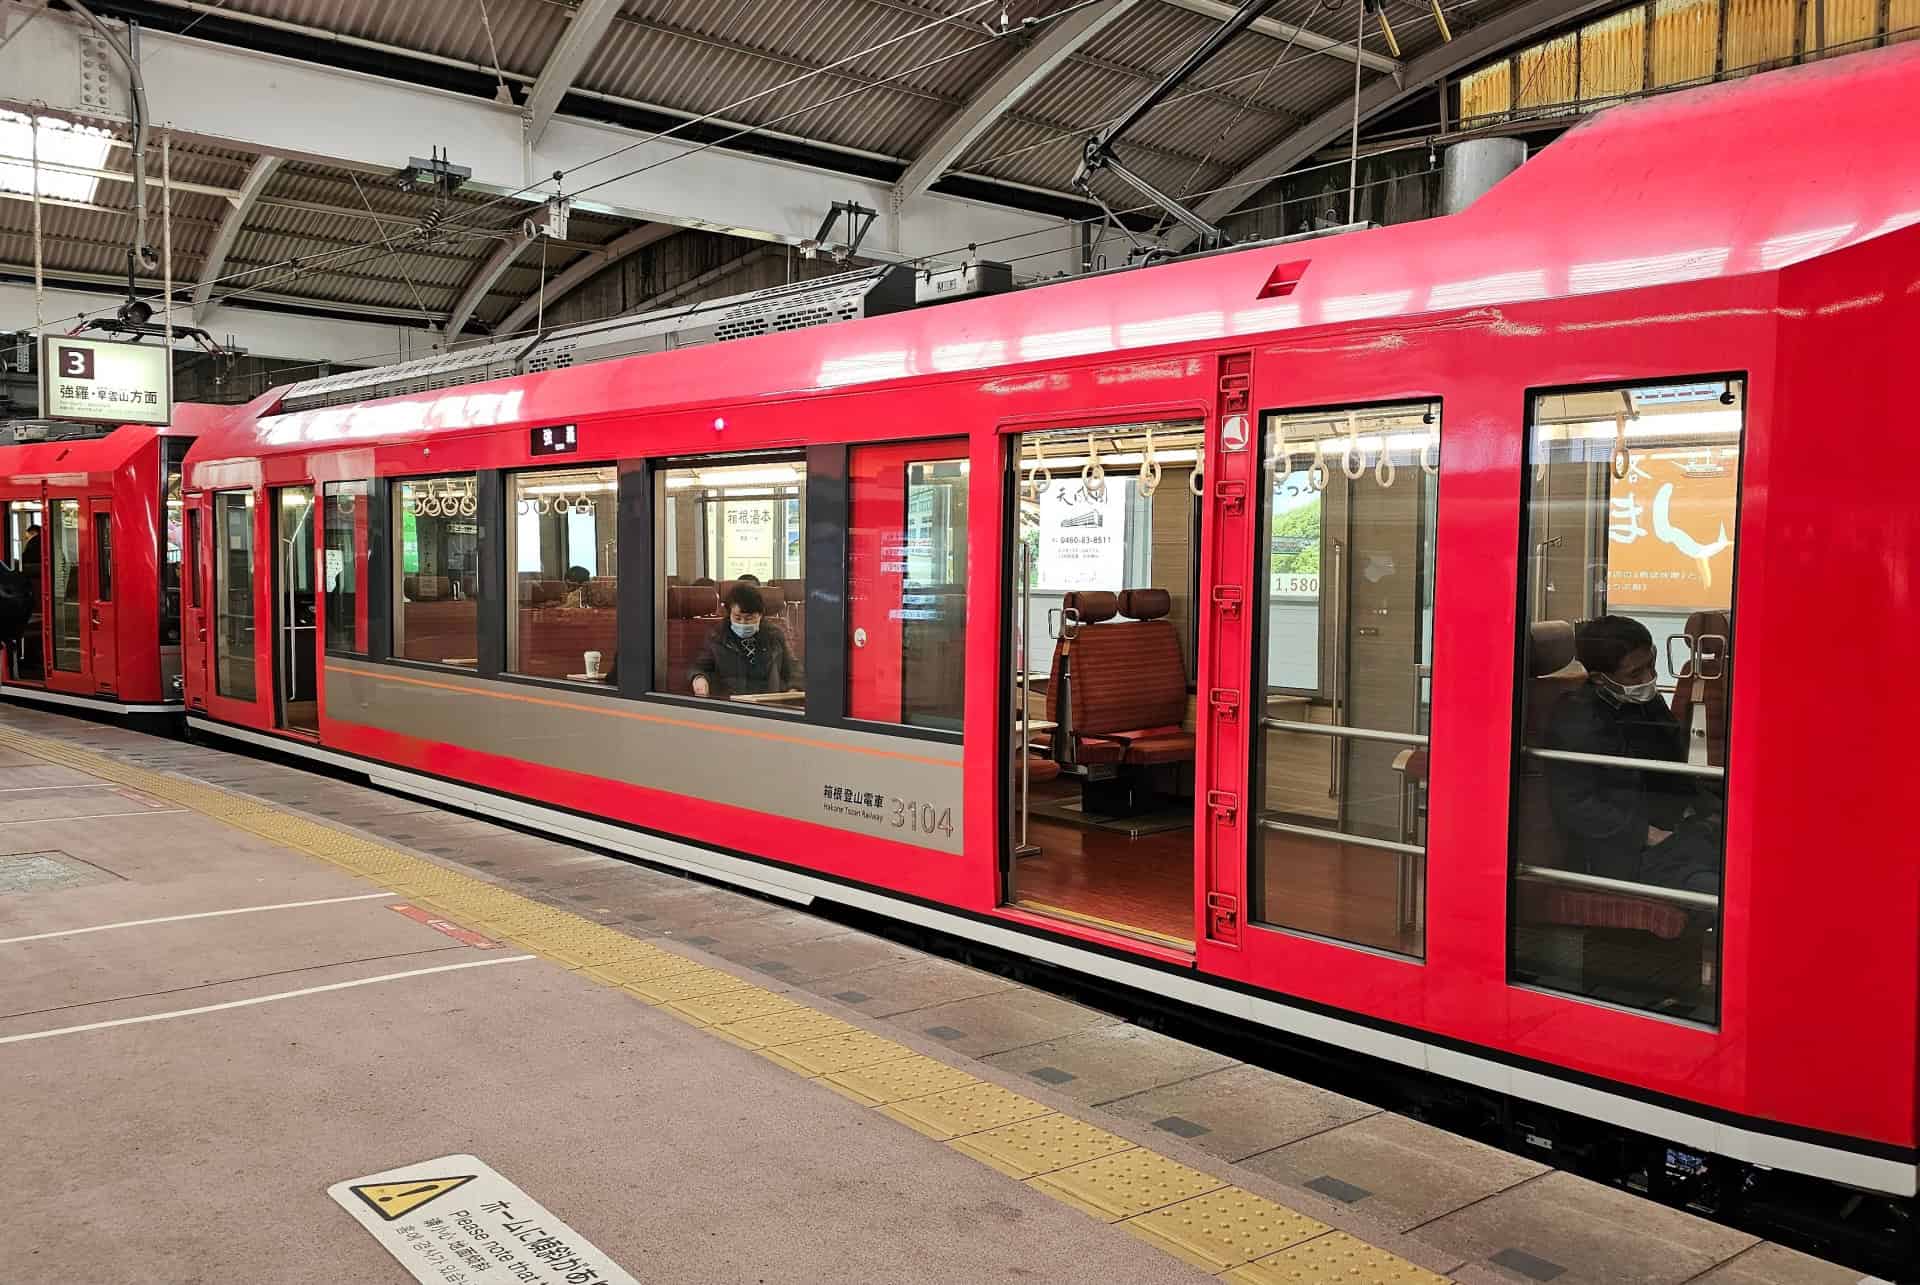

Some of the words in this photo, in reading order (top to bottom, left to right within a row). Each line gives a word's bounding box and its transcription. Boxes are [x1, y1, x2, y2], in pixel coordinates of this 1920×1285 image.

[67, 351, 85, 374] 3
[1276, 578, 1318, 593] 1,580
[824, 785, 884, 808] 箱根登山電車
[891, 798, 954, 839] 3104
[448, 1209, 489, 1241] Please
[481, 1240, 514, 1262] note
[508, 1261, 541, 1284] that
[480, 1200, 608, 1285] ホームに傾斜があ
